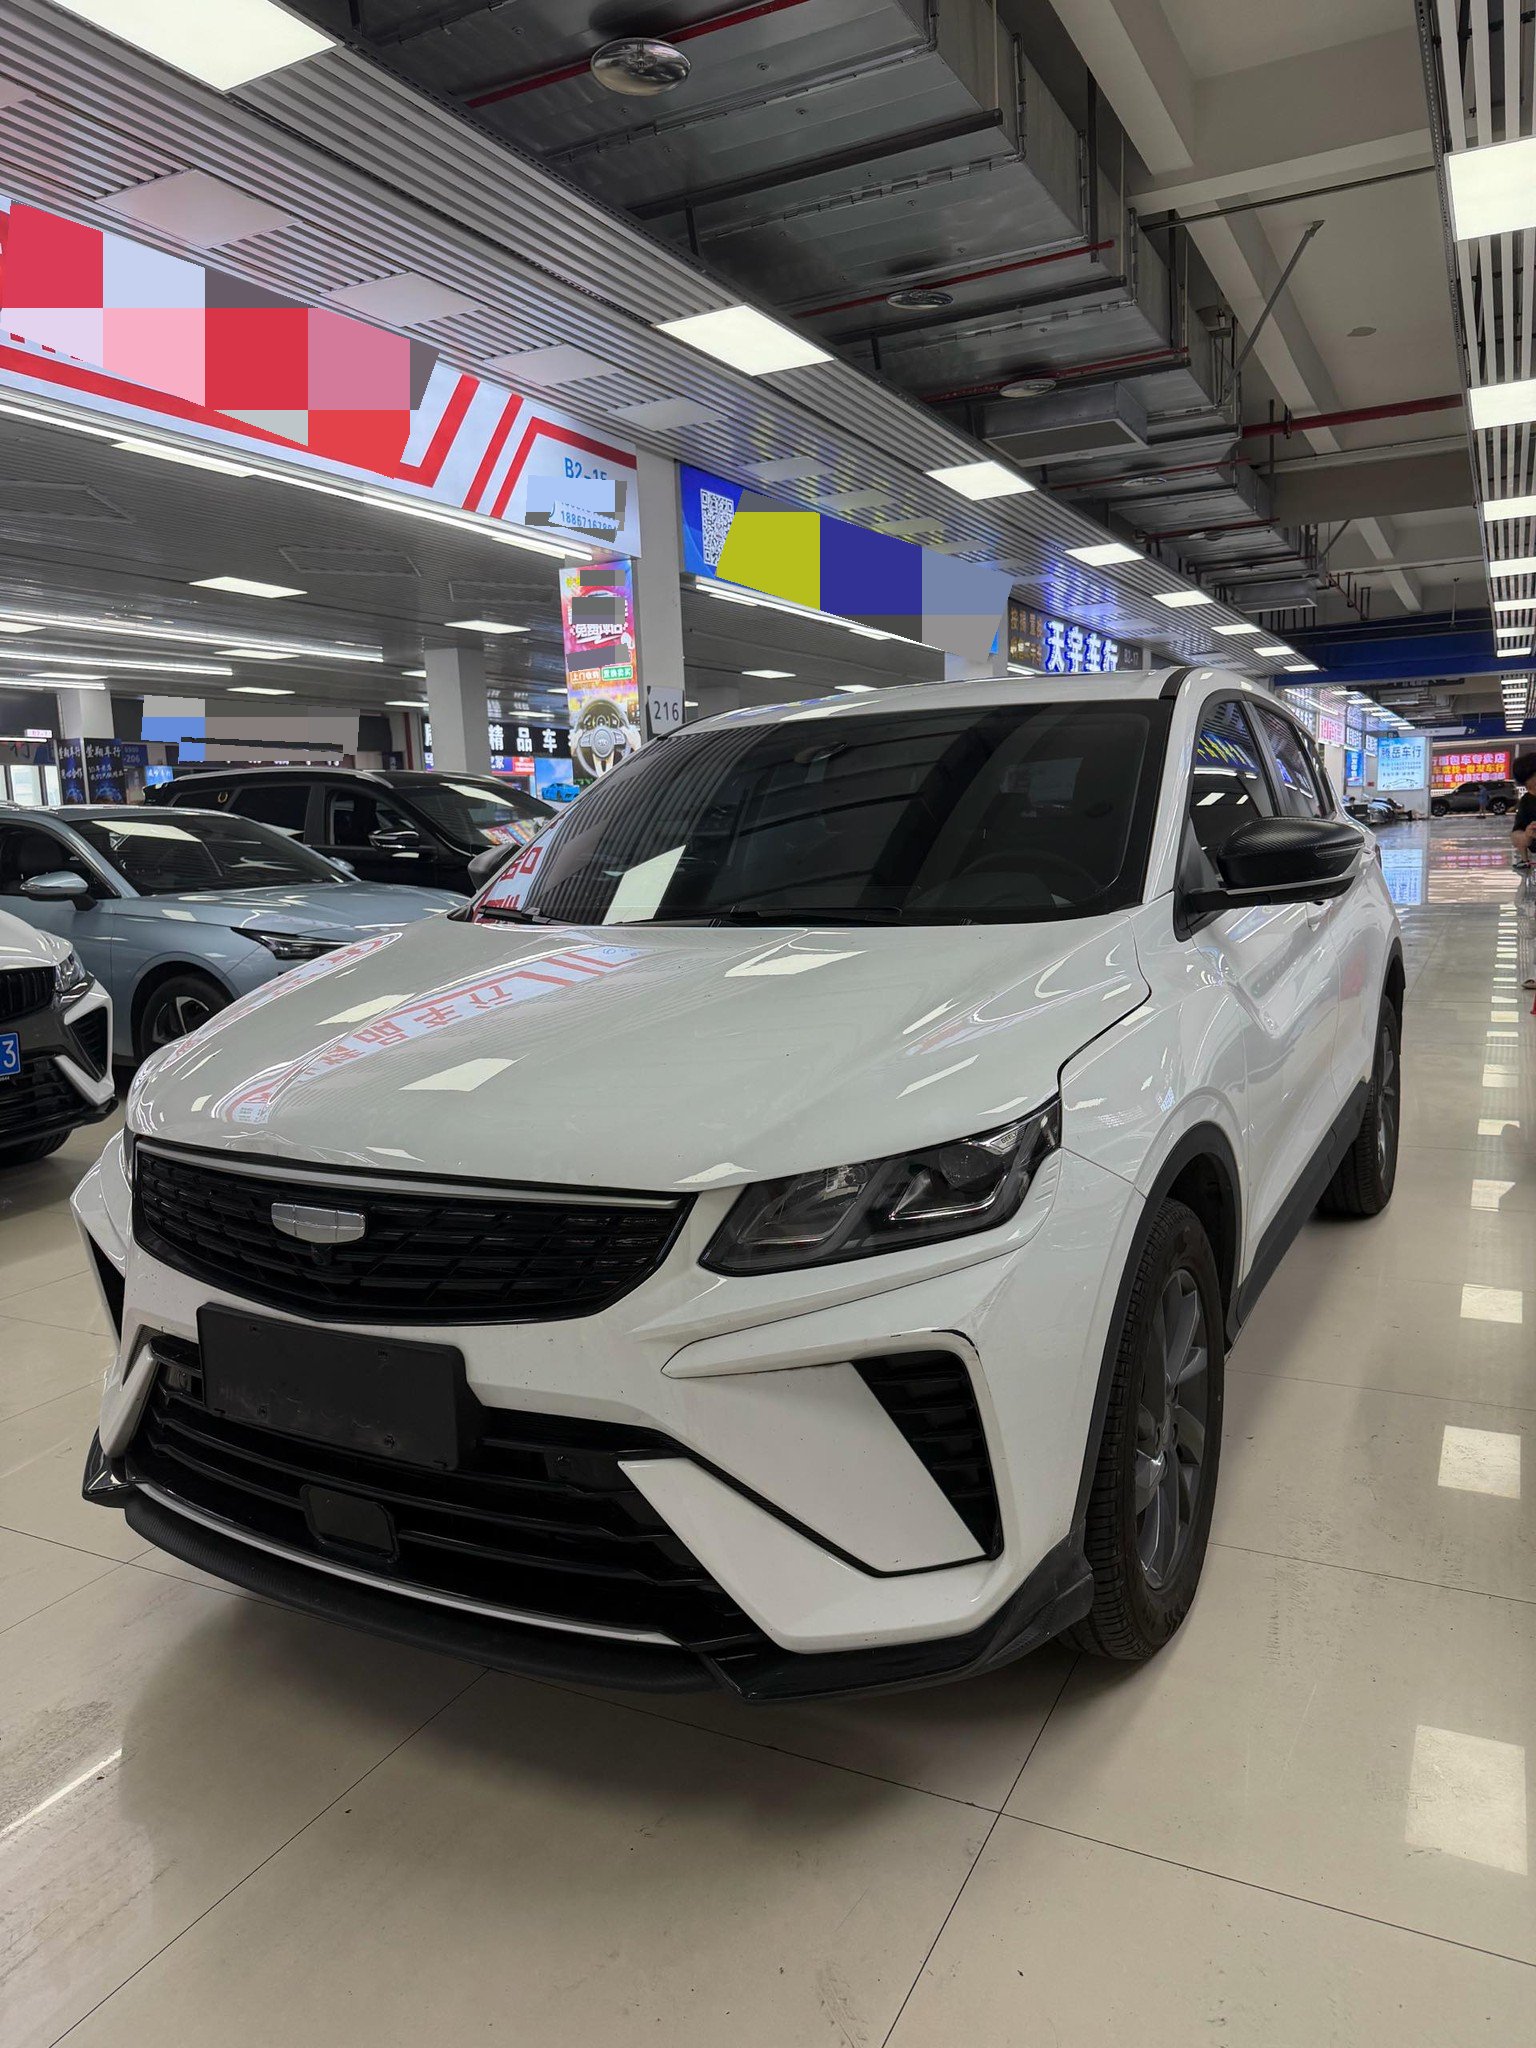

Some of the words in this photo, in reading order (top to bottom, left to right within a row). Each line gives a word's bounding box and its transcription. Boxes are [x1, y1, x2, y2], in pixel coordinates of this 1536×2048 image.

[1047, 621, 1118, 671] 天宇车行
[653, 700, 680, 722] 216
[488, 724, 572, 753] 精品车
[1000, 1130, 1018, 1144] GEELY
